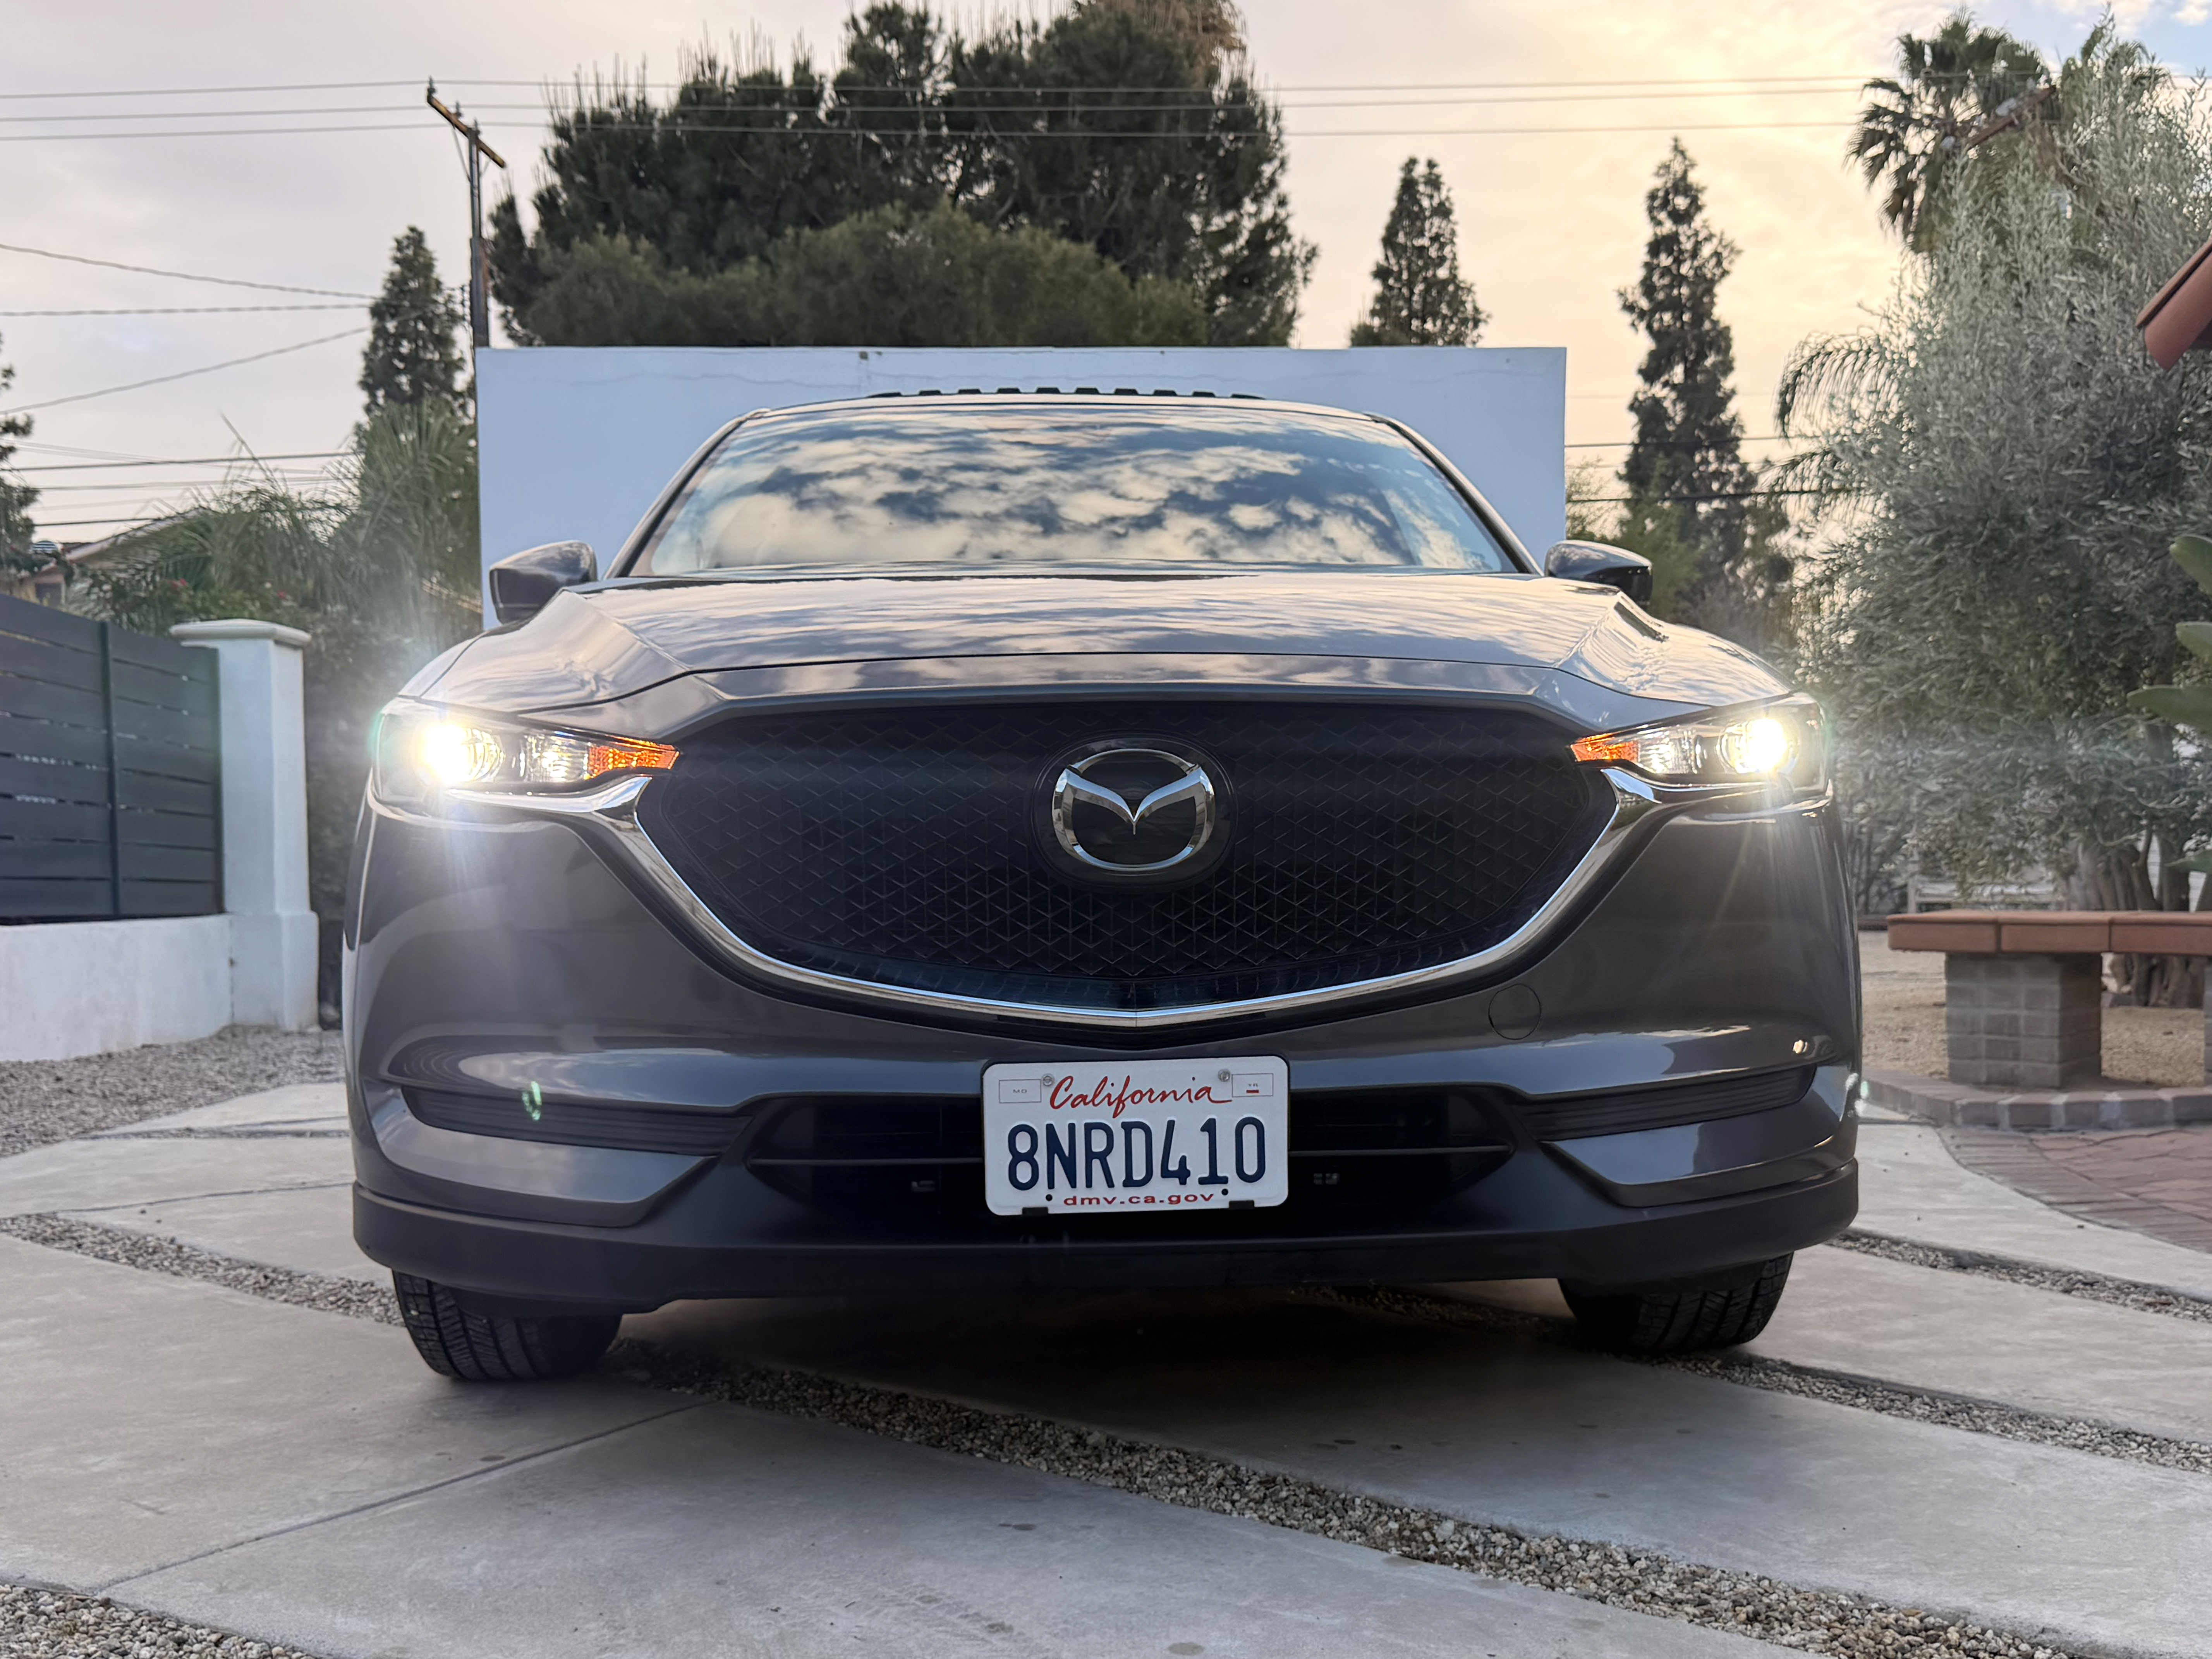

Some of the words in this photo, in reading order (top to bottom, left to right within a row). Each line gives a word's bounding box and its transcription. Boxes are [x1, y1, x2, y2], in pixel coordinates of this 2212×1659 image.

[1049, 1075, 1233, 1118] California
[1007, 1116, 1266, 1191] 8NRD410
[1063, 1193, 1214, 1207] dmv.ca.gov
